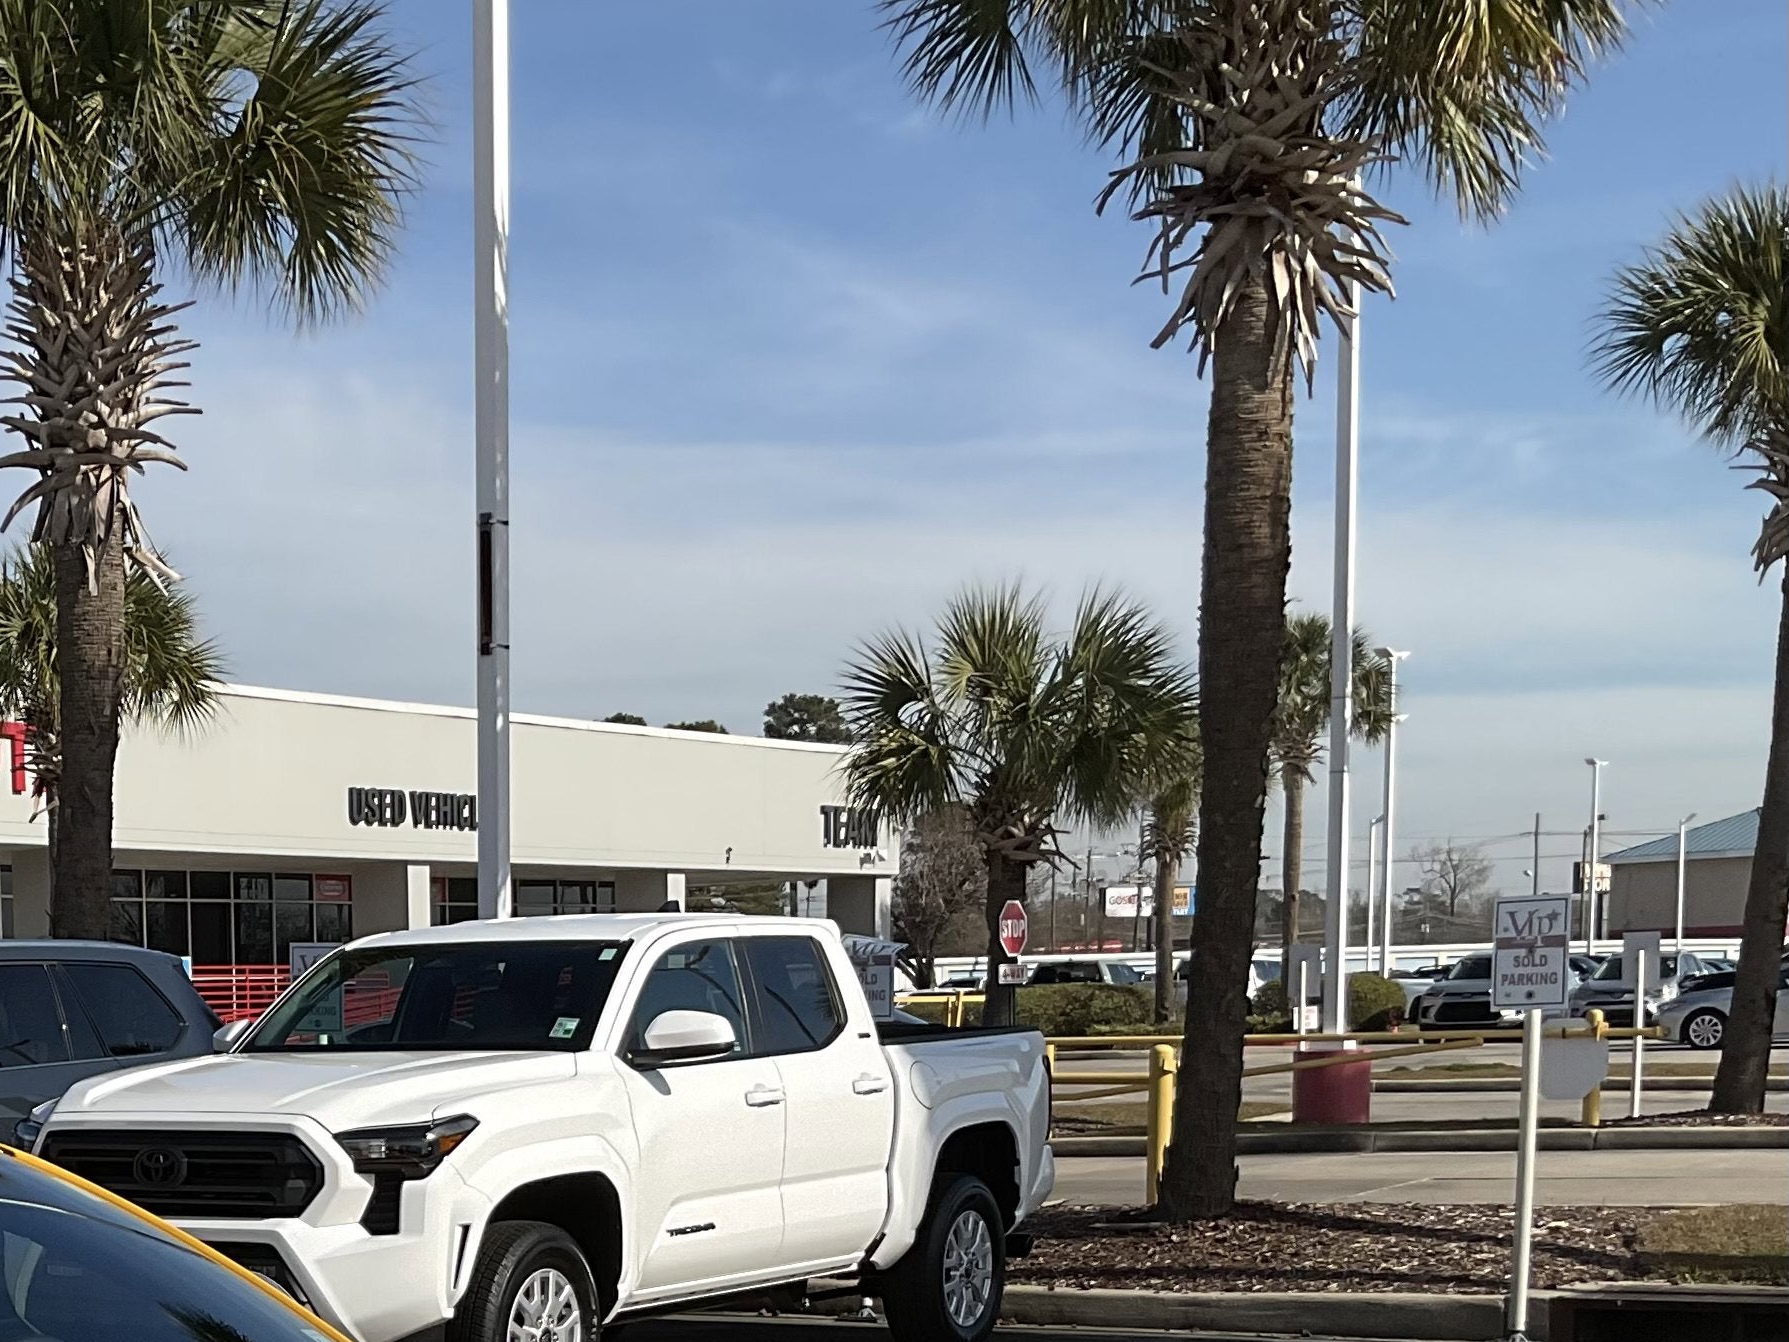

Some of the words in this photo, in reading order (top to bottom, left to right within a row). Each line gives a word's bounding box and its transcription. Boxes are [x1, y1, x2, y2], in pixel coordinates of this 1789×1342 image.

[347, 786, 407, 827] USED
[409, 790, 478, 831] VEHICL
[819, 804, 878, 849] TEAM
[1001, 919, 1025, 938] STOP
[1513, 953, 1548, 968] SOLD
[858, 973, 878, 986] OLD
[1500, 971, 1558, 987] PARKING
